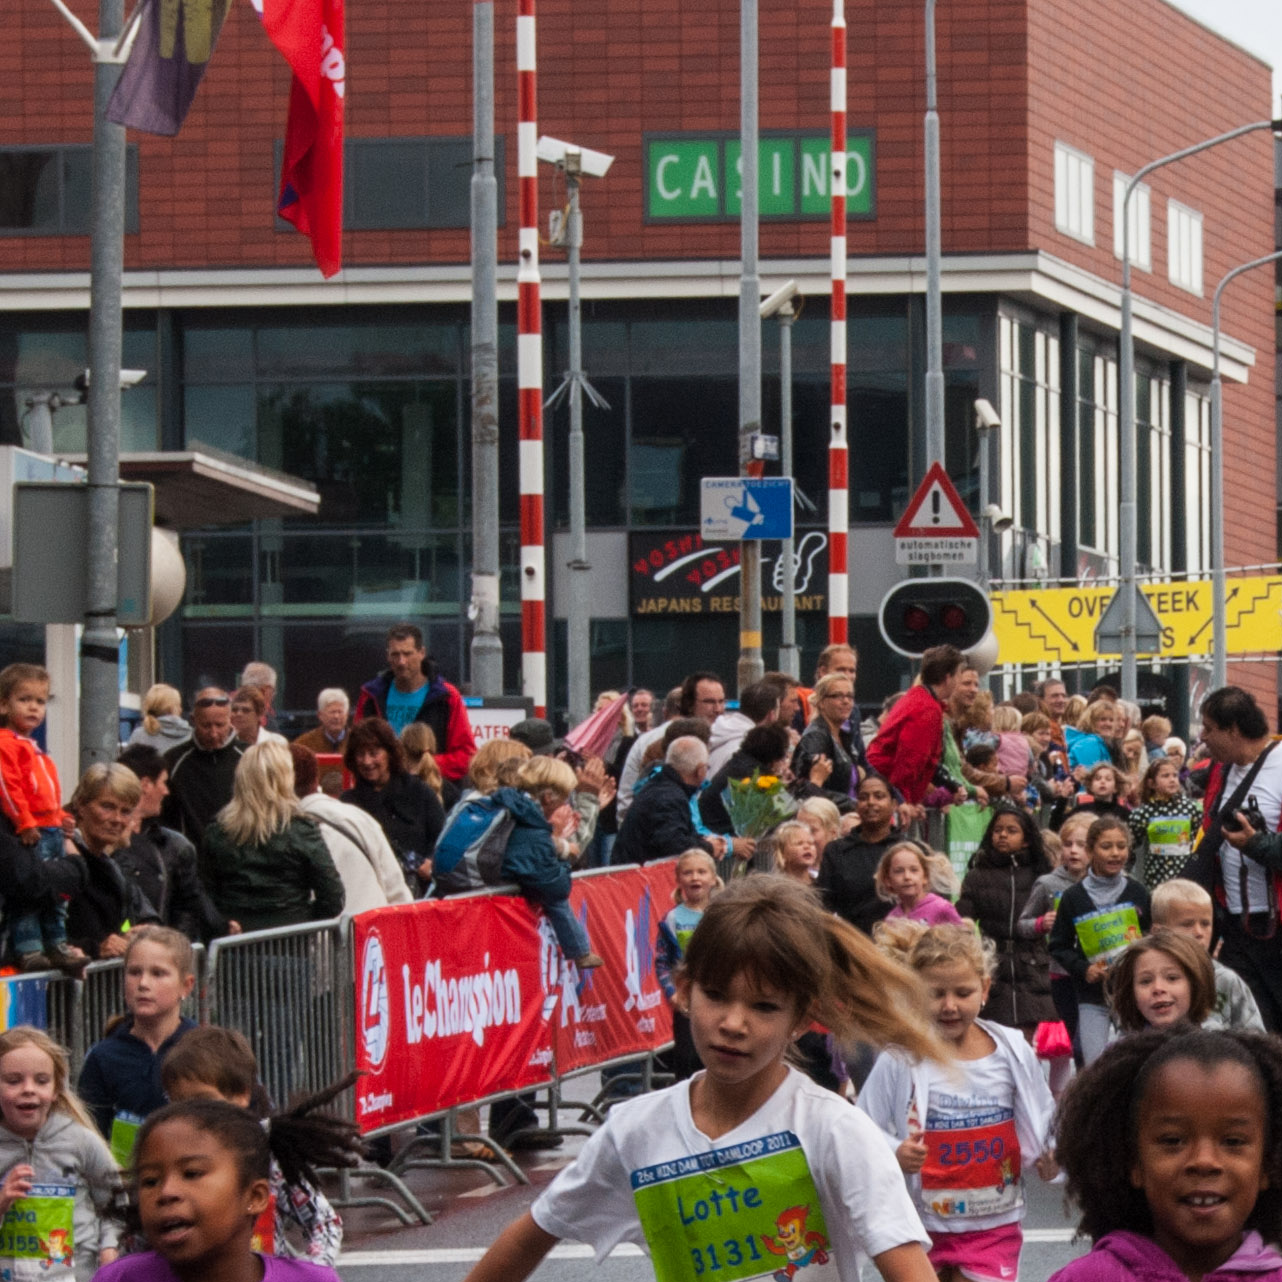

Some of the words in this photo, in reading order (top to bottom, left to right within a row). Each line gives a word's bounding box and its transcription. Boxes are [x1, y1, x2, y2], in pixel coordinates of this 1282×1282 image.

[656, 151, 866, 199] CAINO
[900, 540, 972, 550] automatische
[908, 551, 964, 563] slagbomen
[637, 597, 702, 614] JAPANS
[710, 595, 825, 612] RESAUANT
[678, 1159, 698, 1174] DAM
[700, 1153, 717, 1168] TOT
[717, 1140, 765, 1164] DAMLOOP
[767, 1134, 792, 1150] 2011
[938, 1136, 1005, 1166] 2550
[678, 1186, 763, 1227] Lotte
[691, 1234, 762, 1275] 3131
